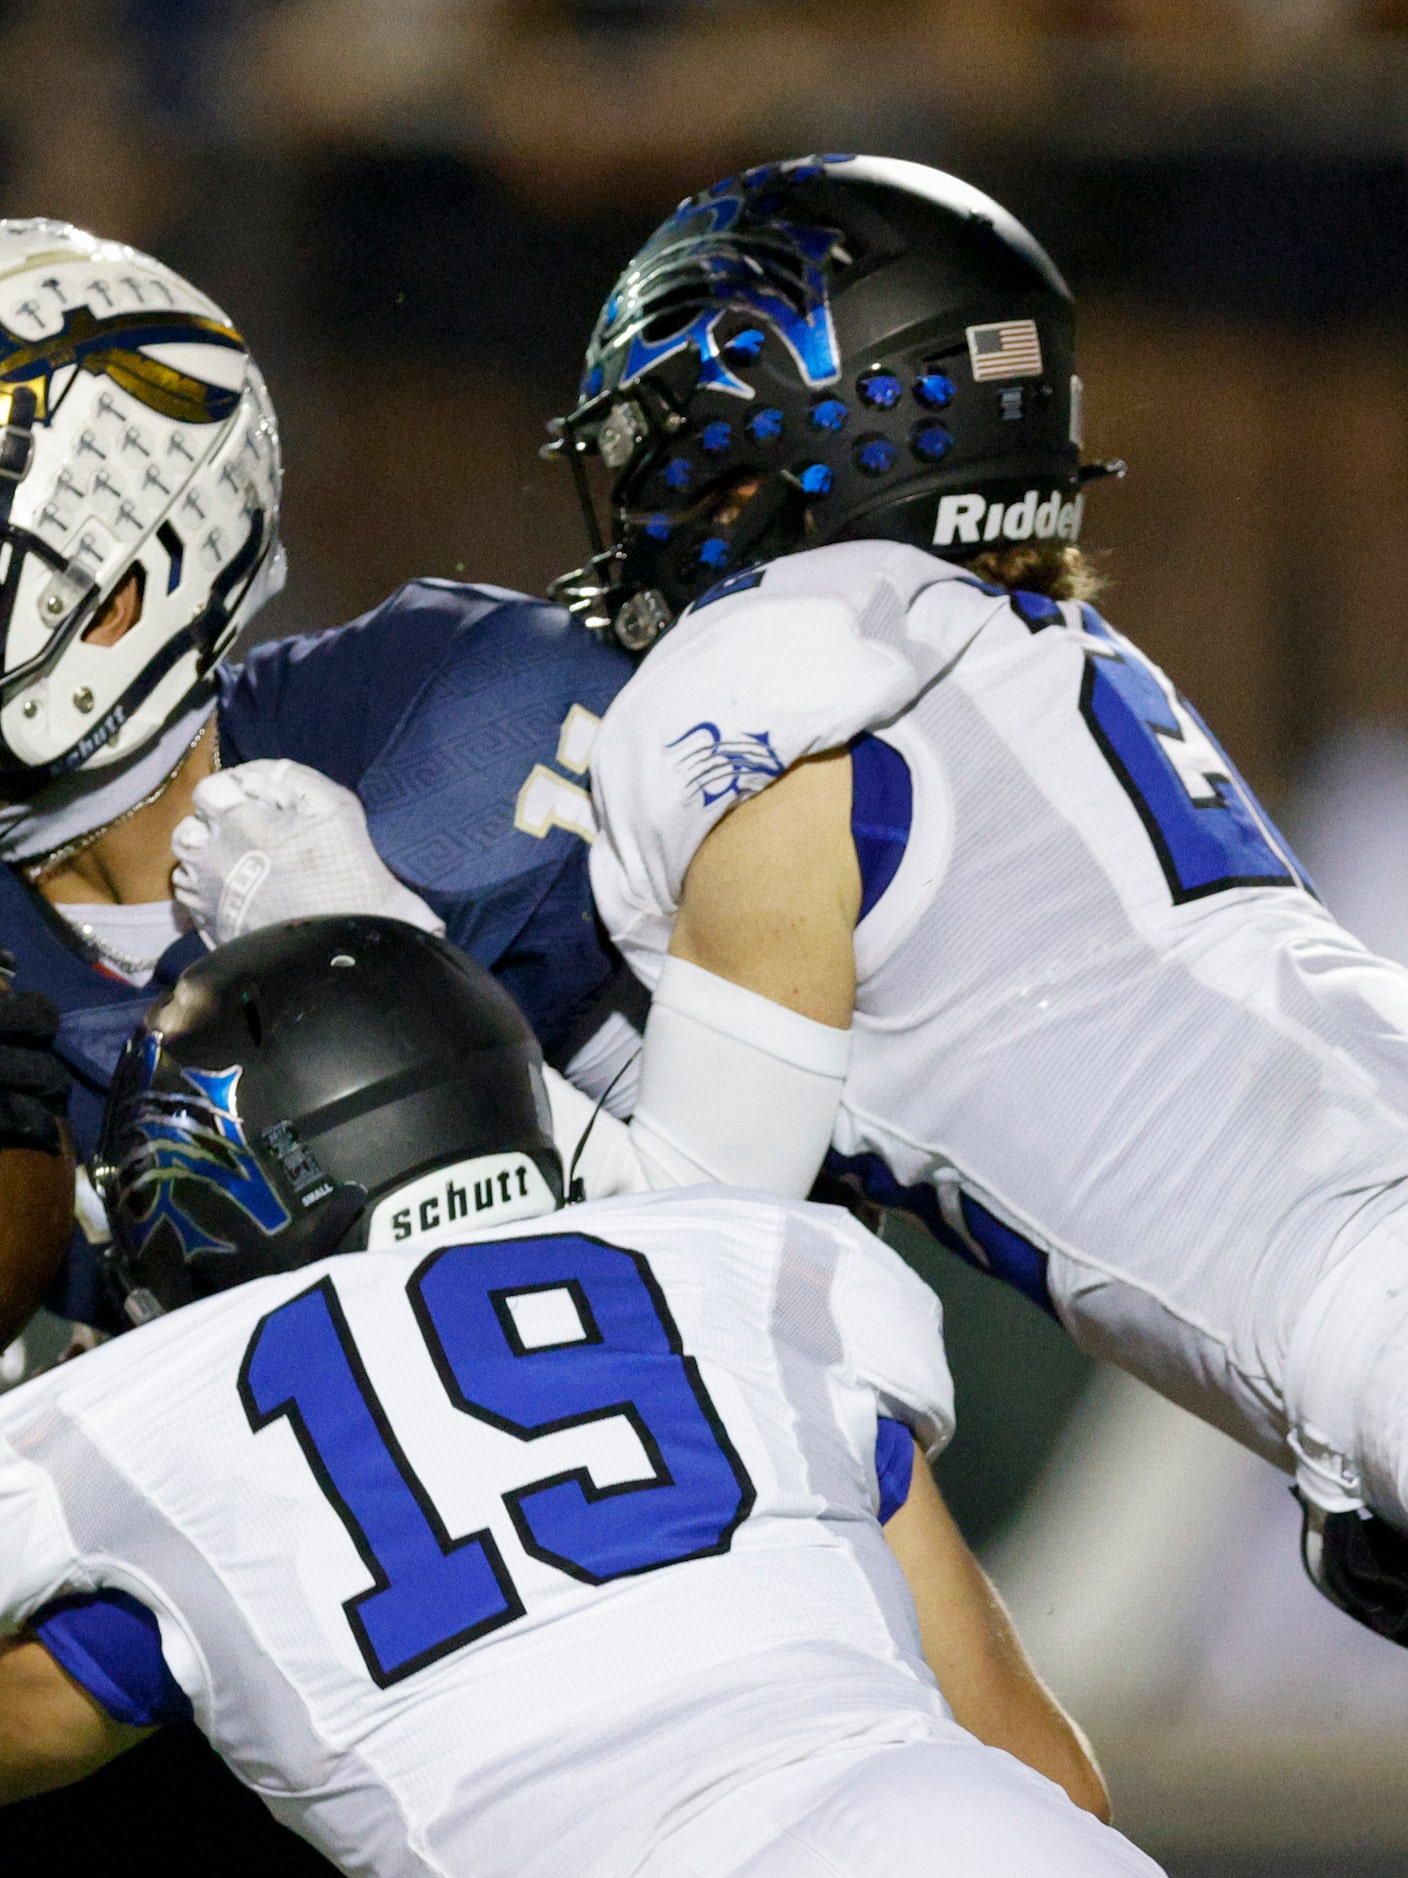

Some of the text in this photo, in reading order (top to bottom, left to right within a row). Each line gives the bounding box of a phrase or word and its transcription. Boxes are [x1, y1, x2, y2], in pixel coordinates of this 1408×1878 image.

[51, 704, 126, 774] chutt
[392, 1165, 528, 1242] schutt
[237, 1231, 758, 1690] 19
